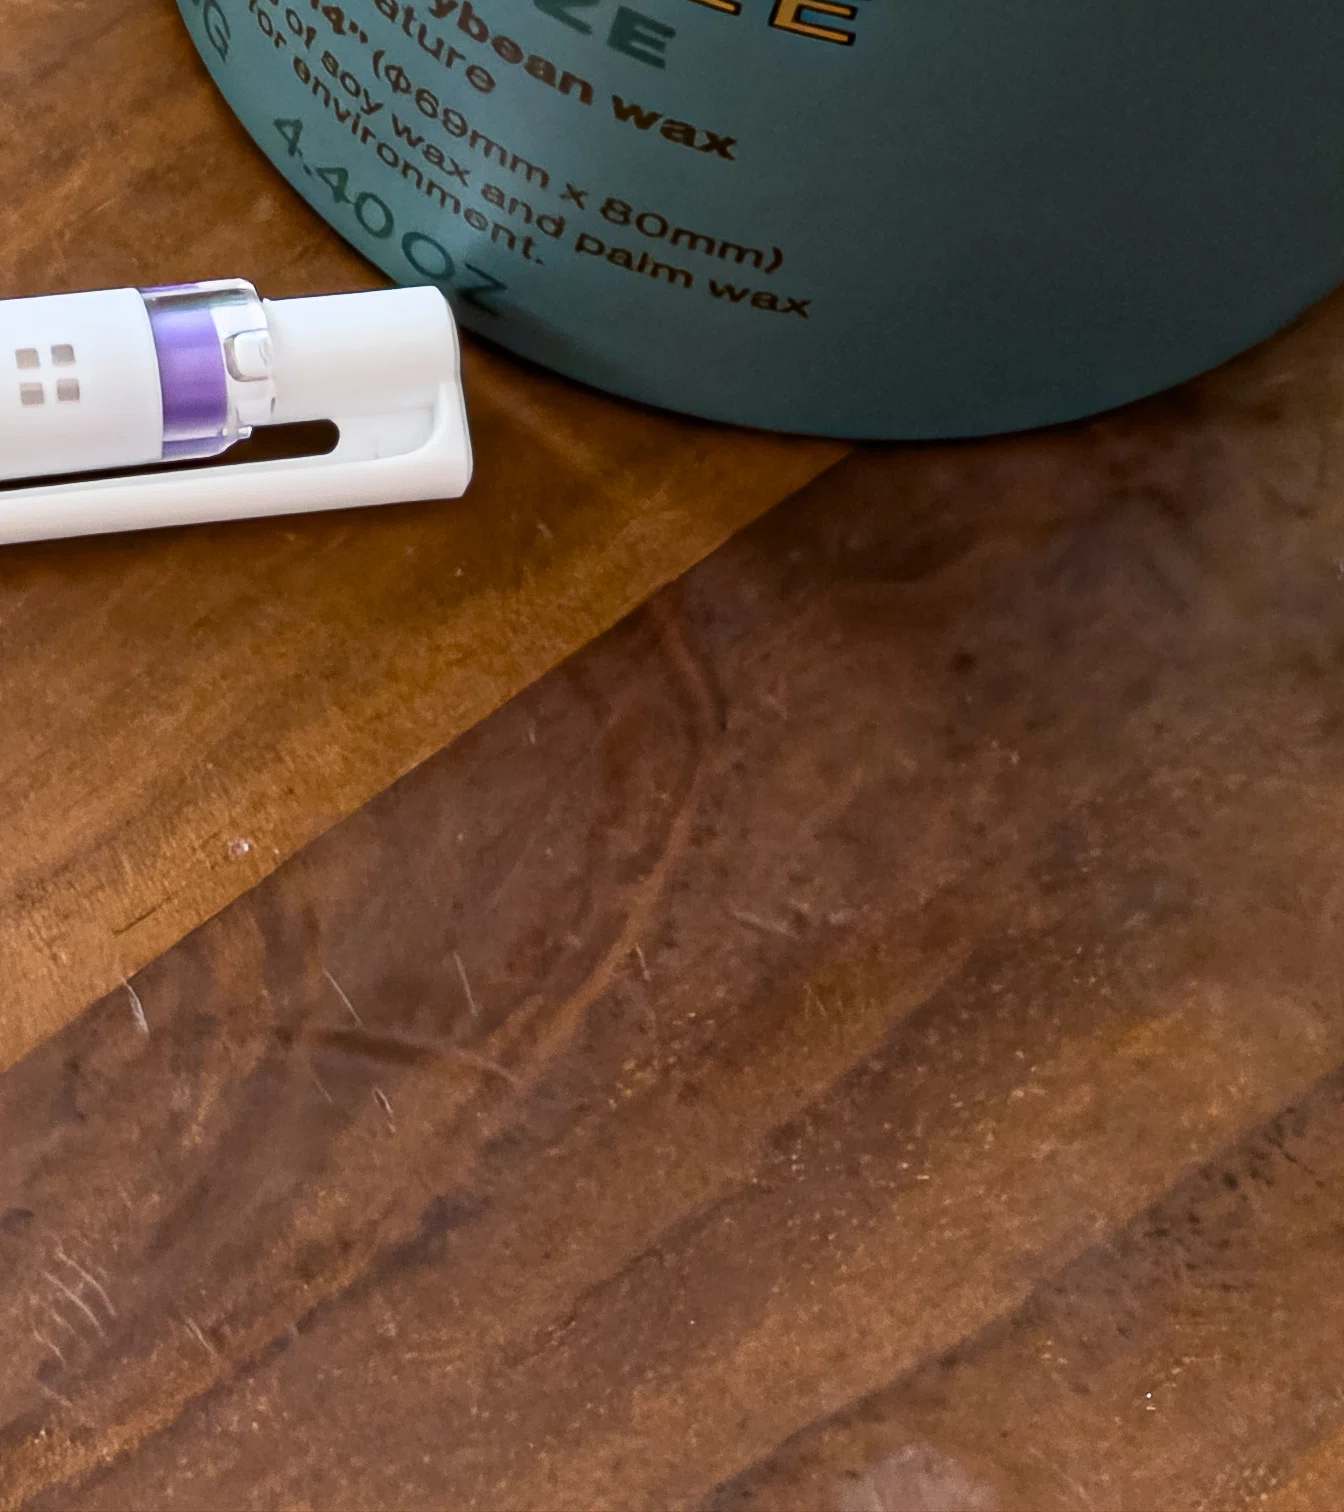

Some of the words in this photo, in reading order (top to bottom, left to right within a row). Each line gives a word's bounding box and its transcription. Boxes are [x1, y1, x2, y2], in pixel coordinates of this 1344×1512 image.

[286, 8, 317, 49] of
[321, 50, 383, 117] soy
[392, 112, 470, 186] wax
[480, 183, 566, 239] and
[575, 231, 694, 289] palm
[708, 278, 811, 319] wax
[293, 55, 543, 264] environment.
[612, 94, 736, 160] wax
[559, 182, 588, 210] x
[599, 196, 784, 275] 80mm)
